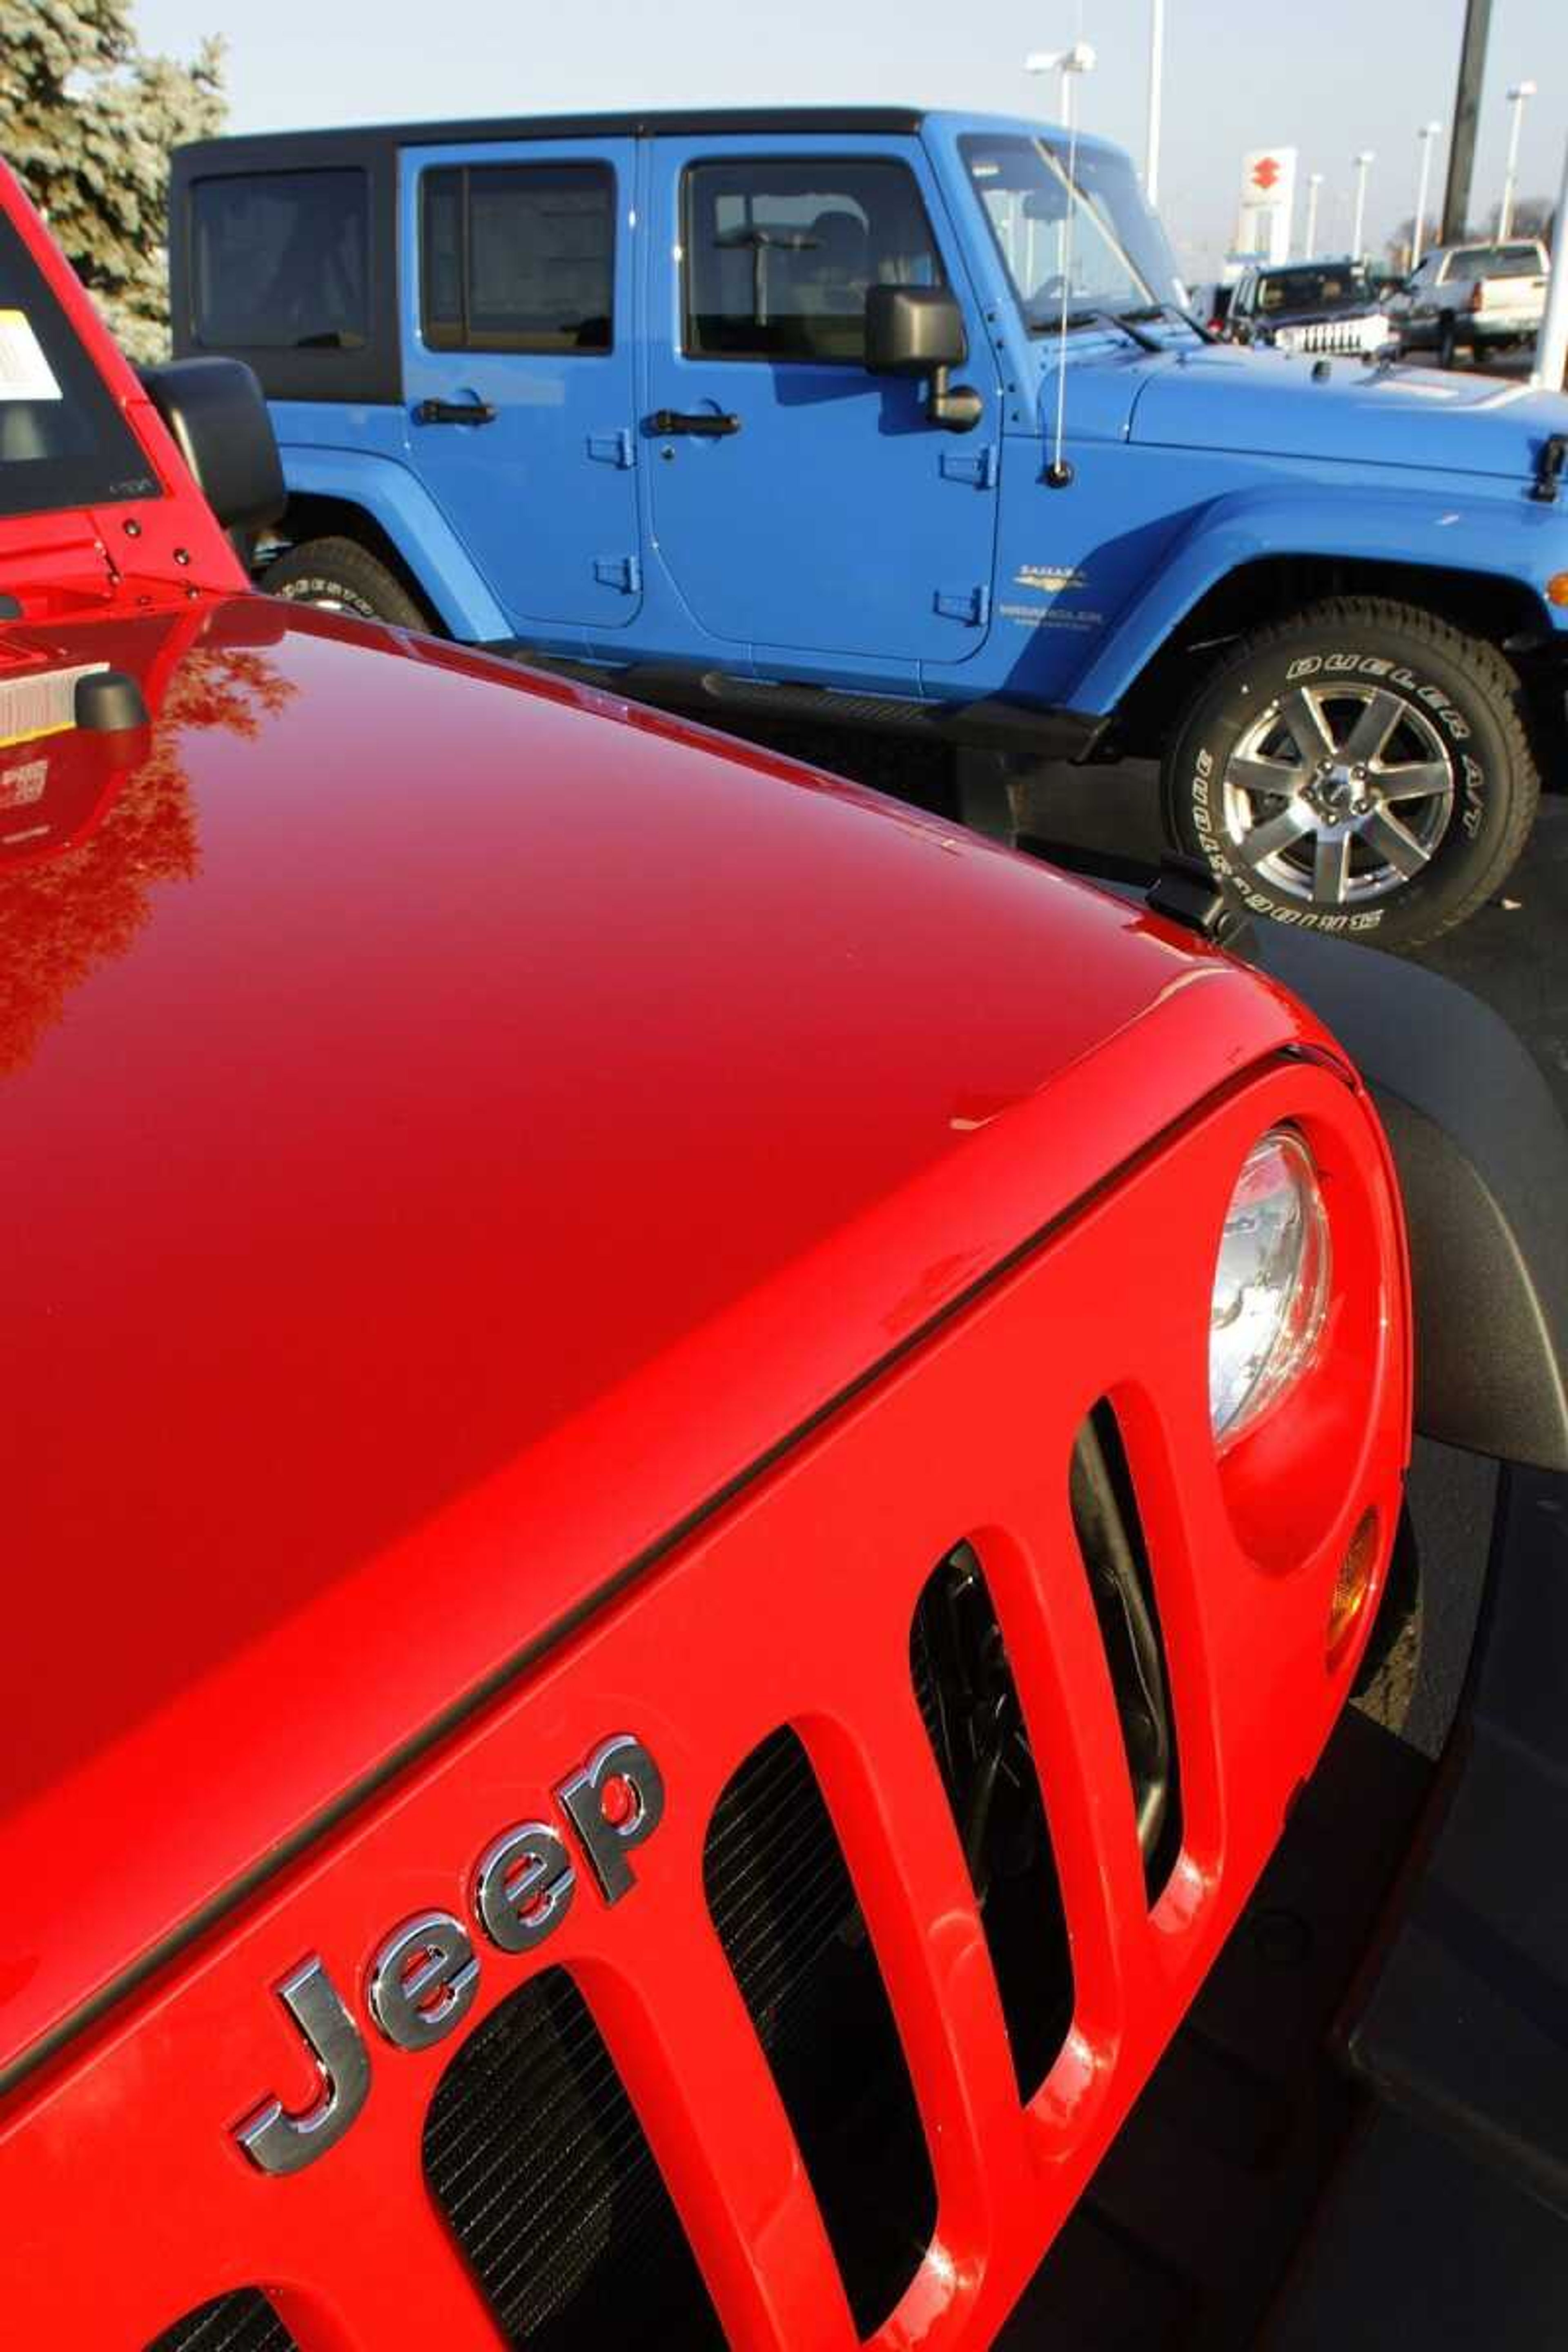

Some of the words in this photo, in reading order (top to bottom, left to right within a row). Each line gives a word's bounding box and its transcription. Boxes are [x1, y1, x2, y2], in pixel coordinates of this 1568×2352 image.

[1286, 654, 1471, 739] DUELER
[1462, 754, 1484, 838] A/T
[233, 1732, 666, 2176] Jeep
